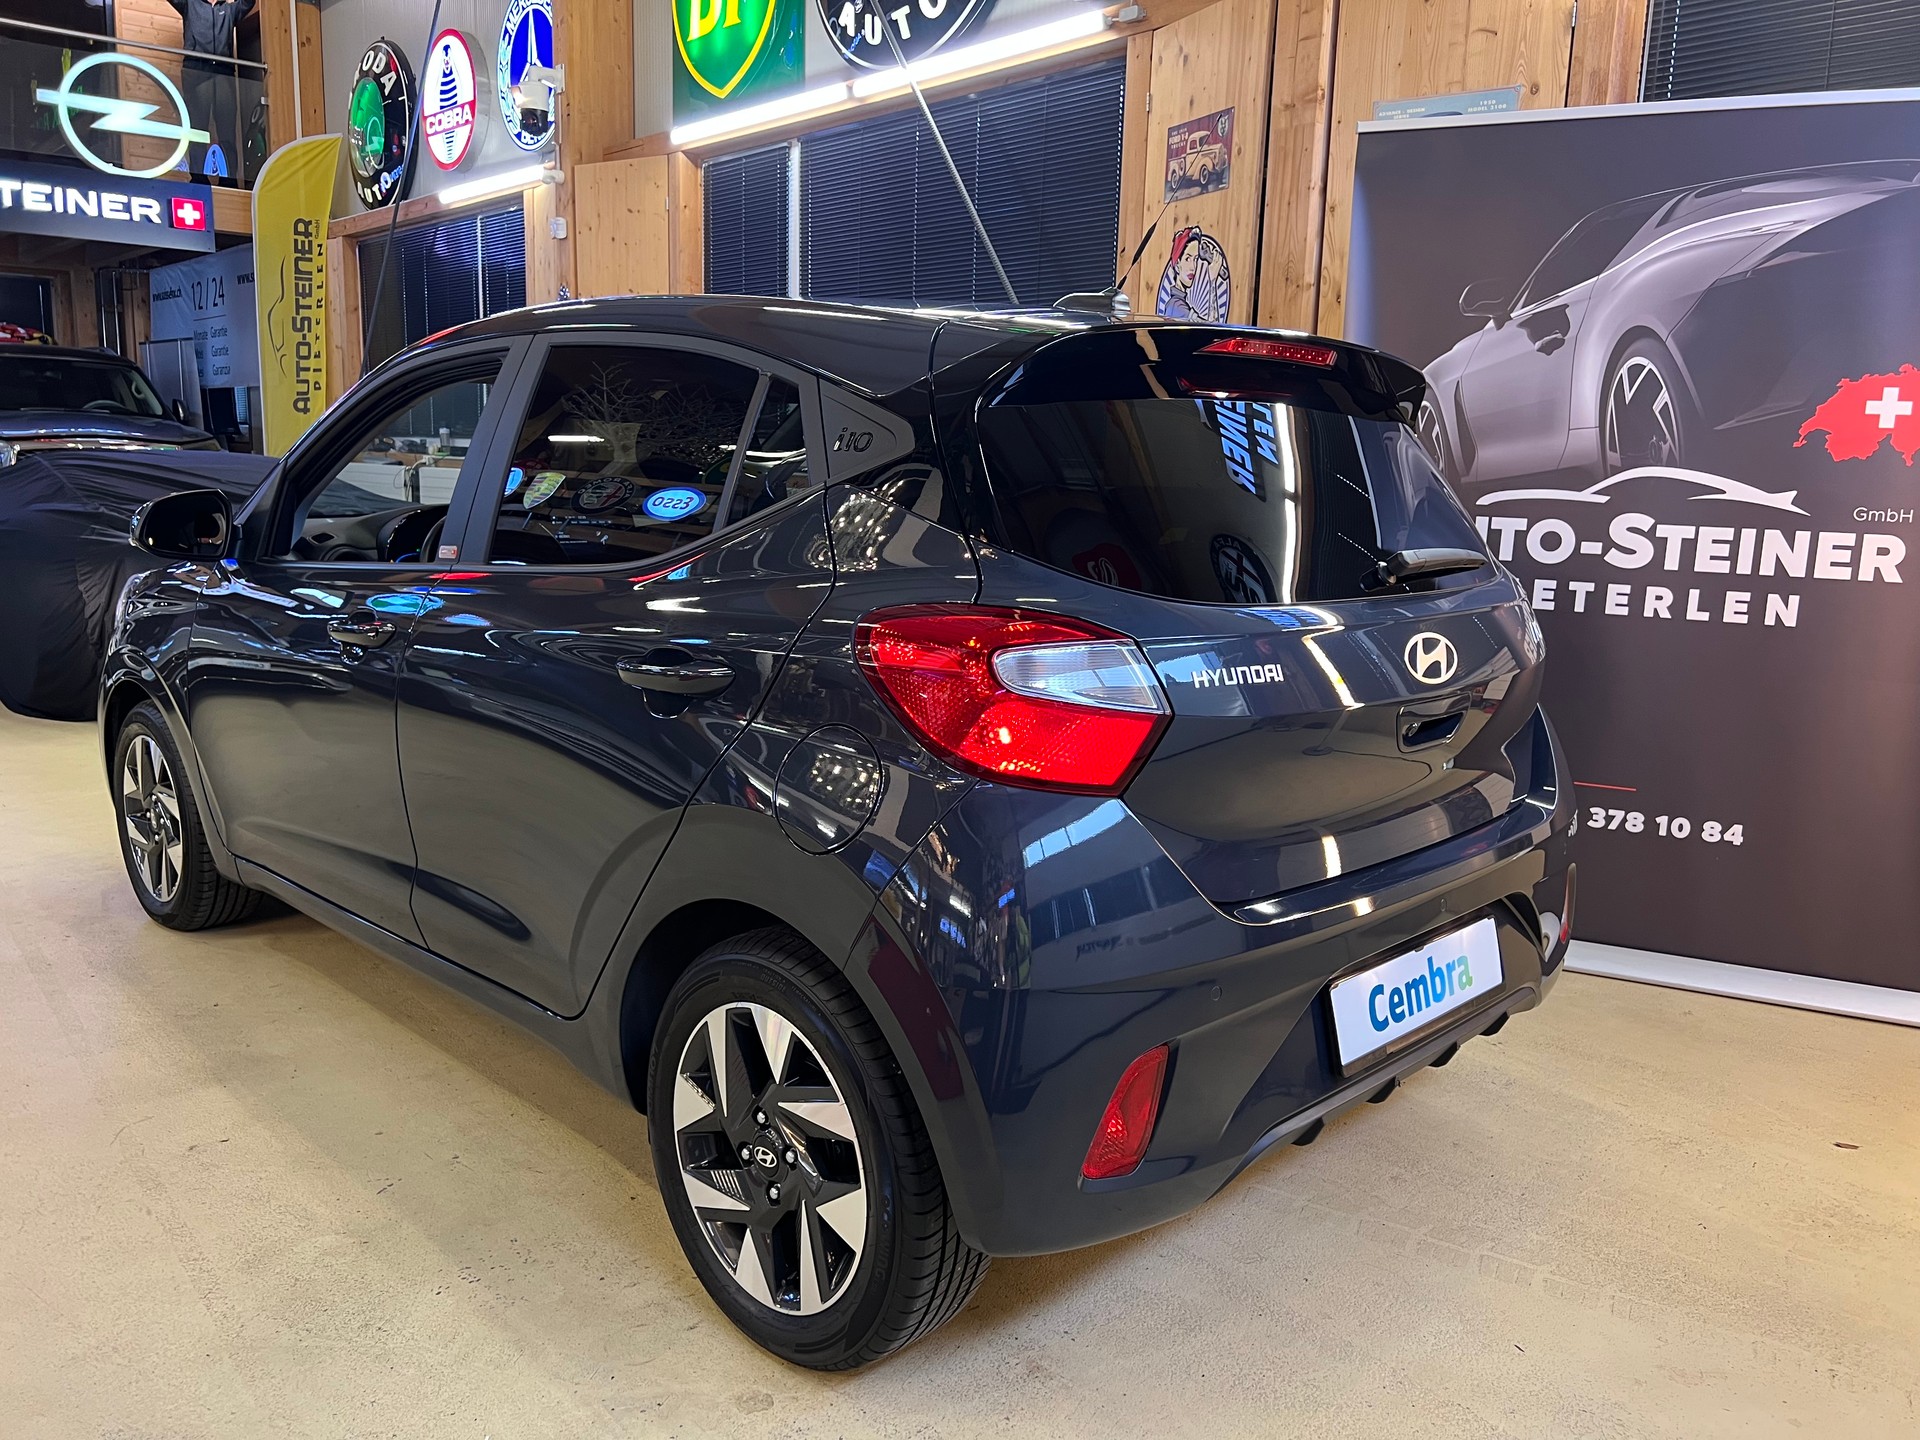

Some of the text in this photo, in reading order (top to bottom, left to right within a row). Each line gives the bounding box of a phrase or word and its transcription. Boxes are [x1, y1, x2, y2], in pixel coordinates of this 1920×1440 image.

[426, 104, 473, 135] COBRA
[0, 176, 162, 224] TEINER
[292, 217, 314, 415] AUTO-STEINER
[833, 426, 874, 453] i10
[1853, 506, 1914, 524] GmbH
[1531, 578, 1801, 628] ETERLEN
[1191, 663, 1285, 689] HYUNDAI
[1587, 806, 1744, 846] 378 10 84
[1368, 952, 1474, 1033] Cembra
